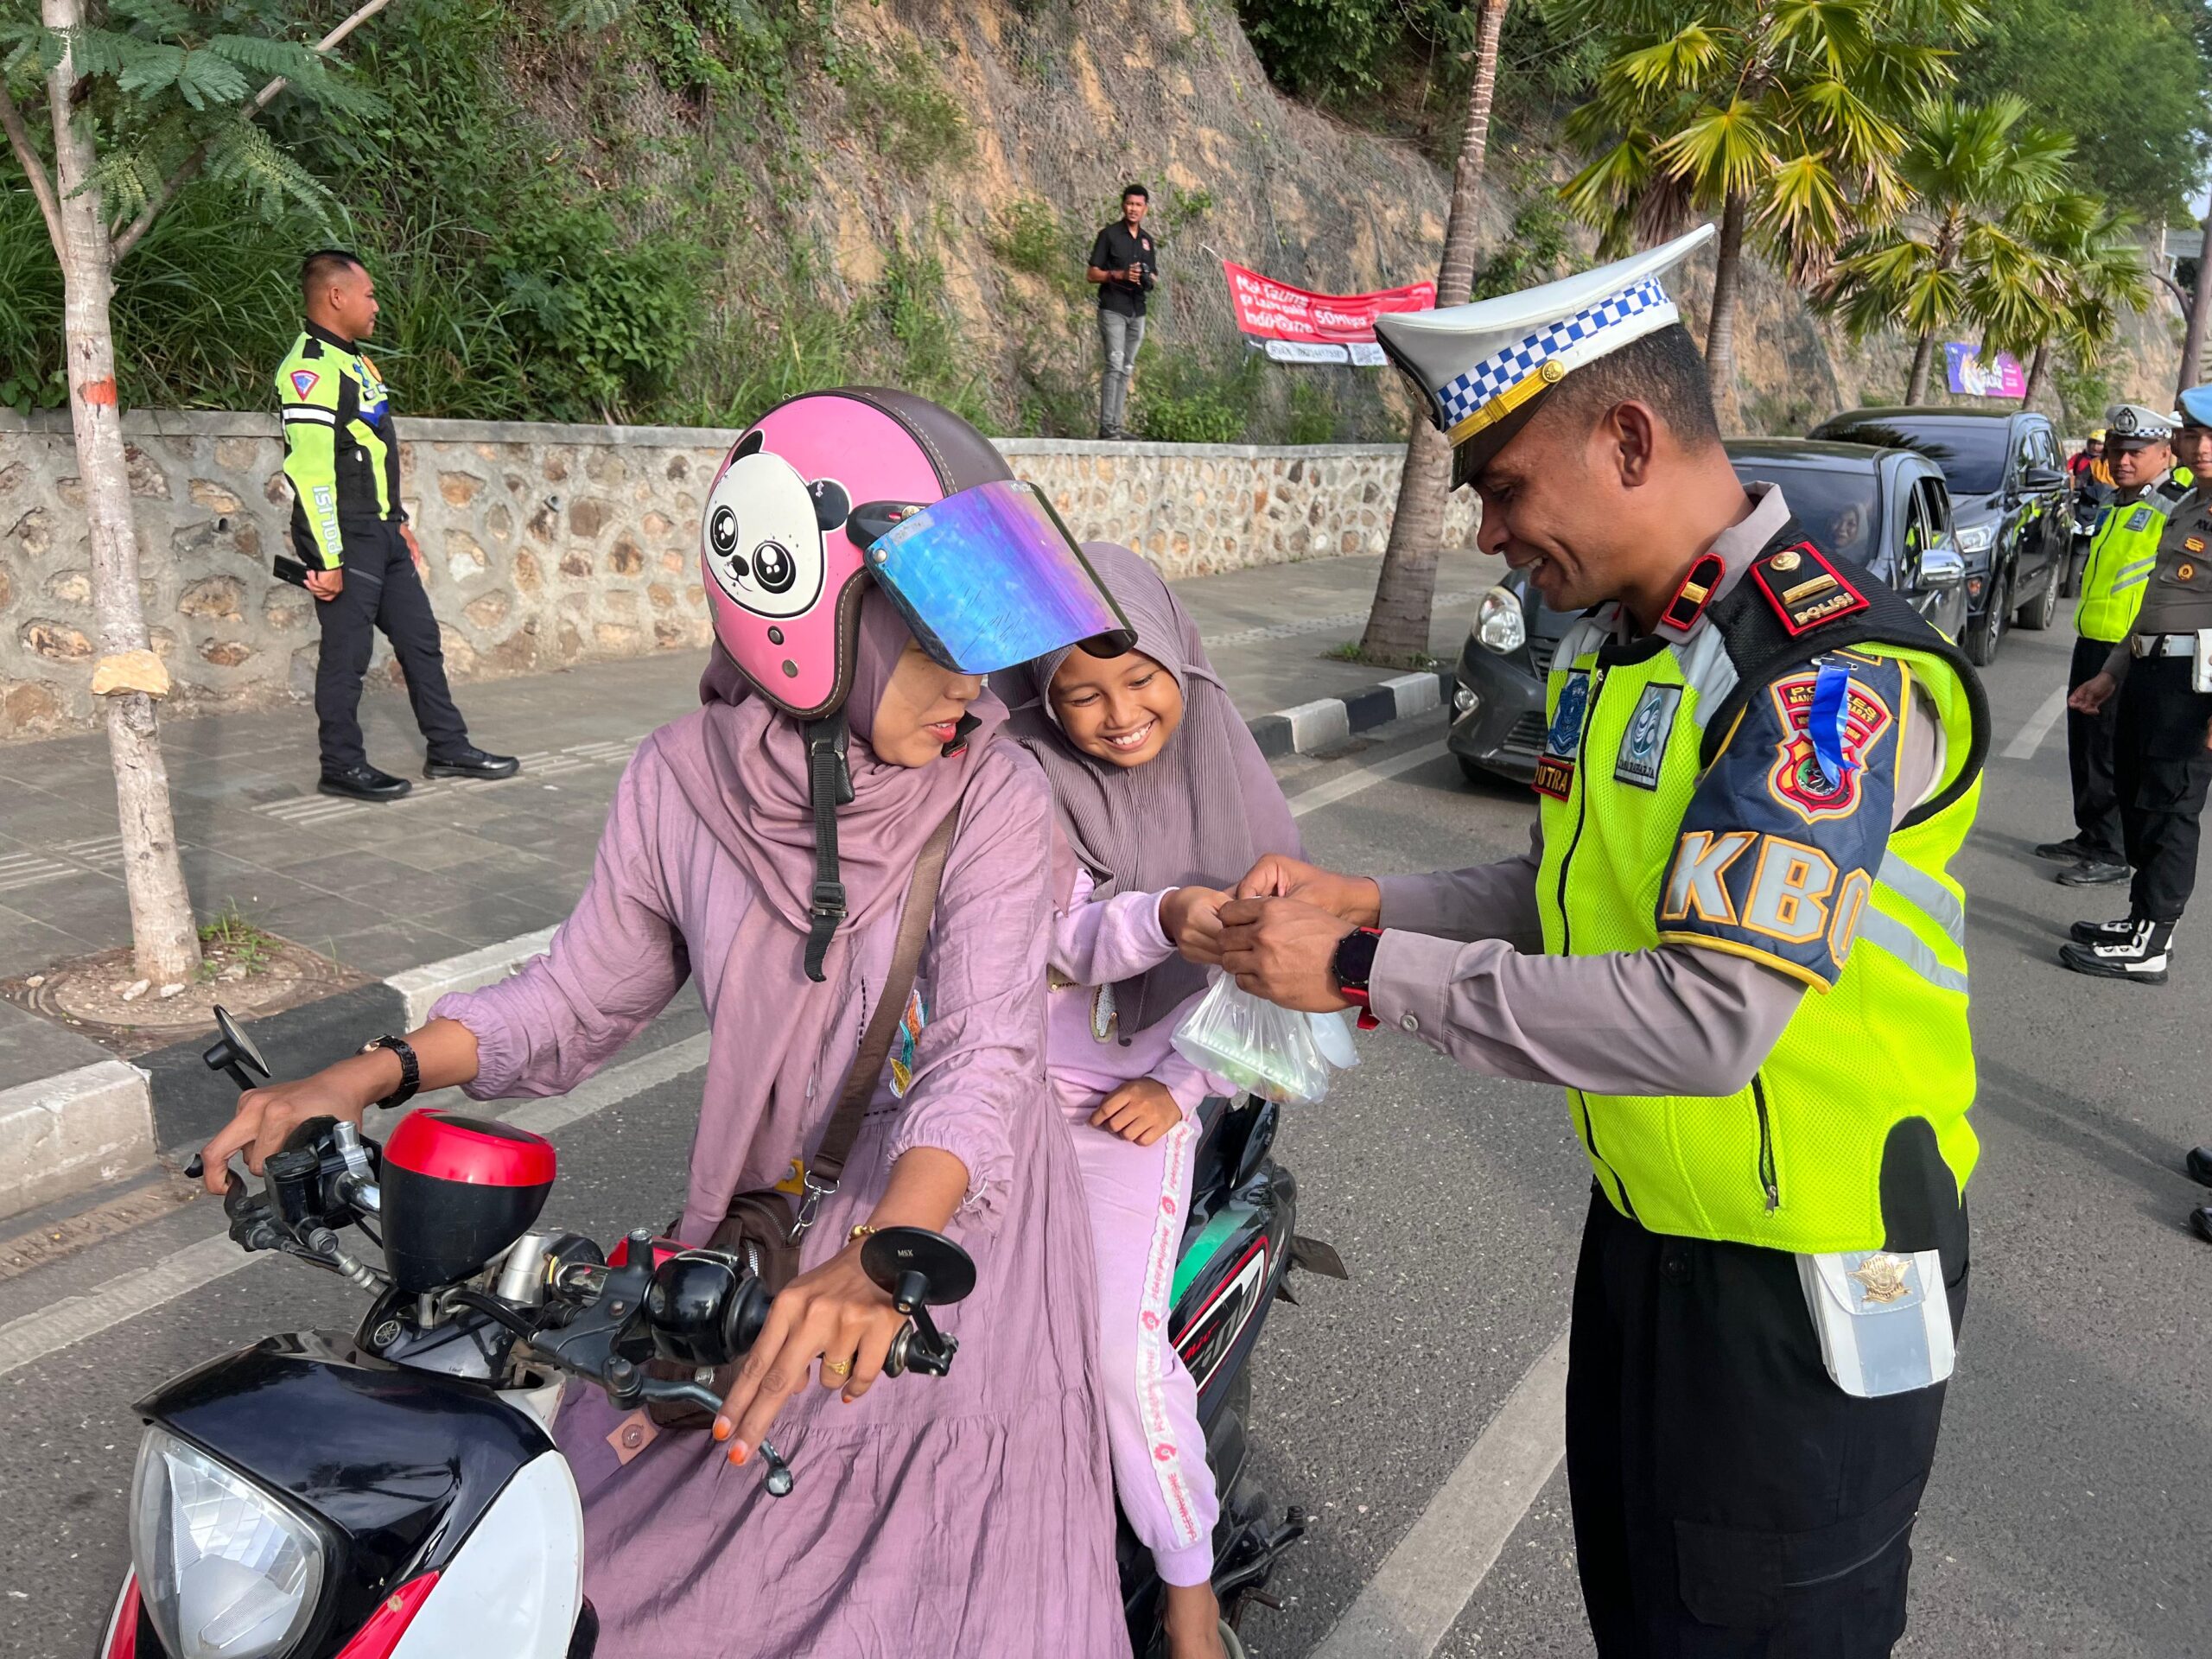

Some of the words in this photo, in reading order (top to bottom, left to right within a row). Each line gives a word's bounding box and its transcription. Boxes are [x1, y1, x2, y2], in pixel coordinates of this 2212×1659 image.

[312, 485, 344, 554] POLISI
[1794, 592, 1855, 626] POLISI
[1661, 830, 1872, 970] KBO
